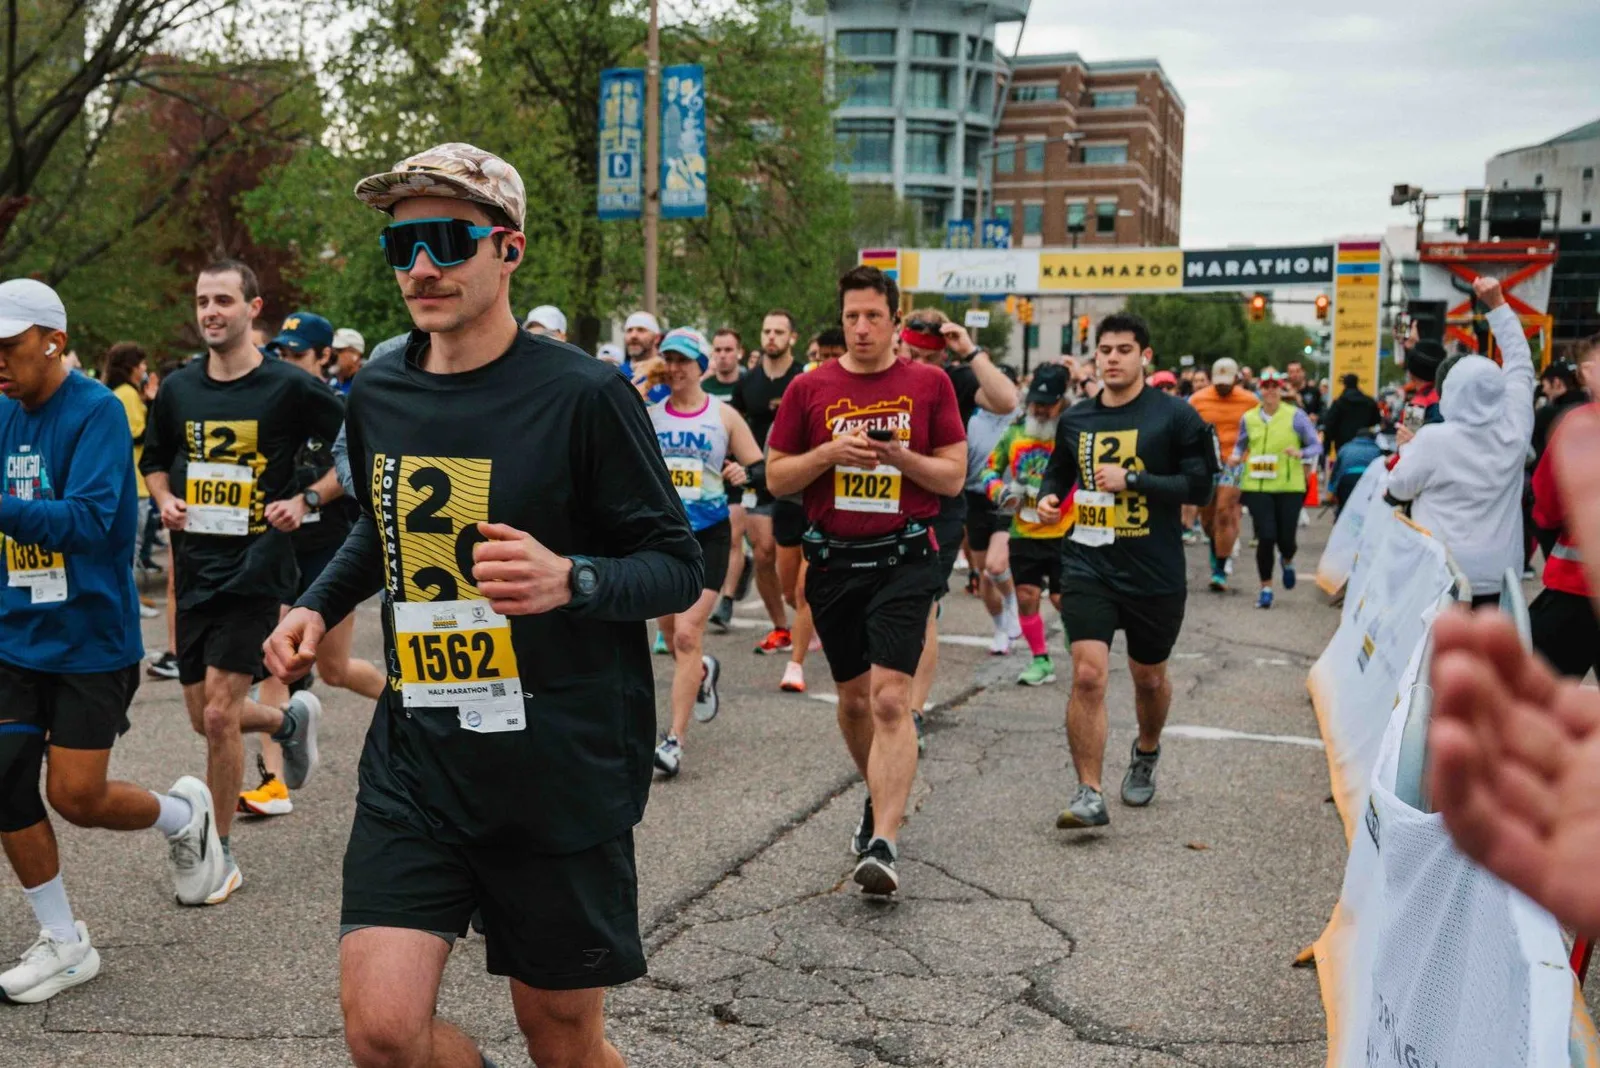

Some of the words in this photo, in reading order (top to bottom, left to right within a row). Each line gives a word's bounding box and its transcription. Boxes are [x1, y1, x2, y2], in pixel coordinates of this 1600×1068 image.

[1043, 264, 1178, 277] KALAMAZOO
[1187, 257, 1330, 277] MARATHON
[944, 272, 1017, 289] ZEIGLER
[671, 470, 695, 487] 53
[842, 474, 893, 499] 1202
[194, 480, 242, 506] 1660
[382, 457, 398, 592] MARATHON
[1116, 528, 1151, 538] RATHON
[408, 632, 500, 681] 1562
[427, 688, 446, 696] HALF
[446, 686, 489, 695] MARATHON
